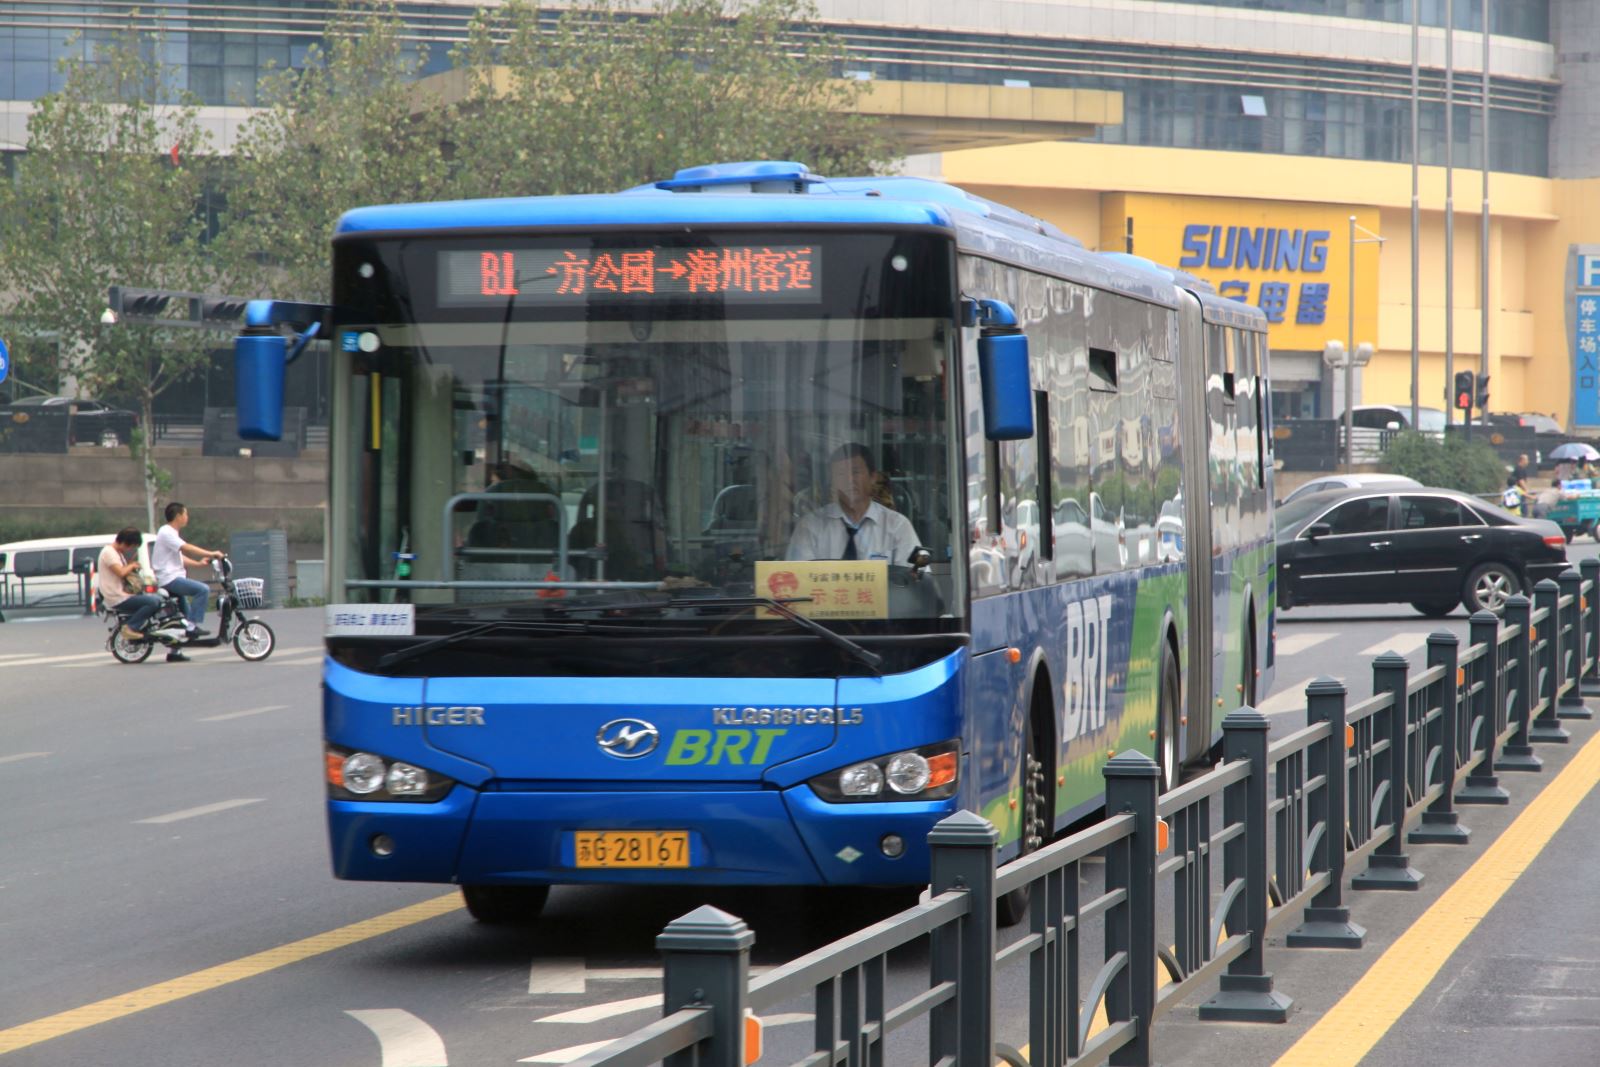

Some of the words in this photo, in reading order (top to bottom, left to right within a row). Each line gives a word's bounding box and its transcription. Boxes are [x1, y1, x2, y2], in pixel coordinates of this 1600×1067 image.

[1179, 224, 1330, 272] SUNING
[809, 588, 874, 605] 示范线
[1062, 594, 1112, 744] BRT
[392, 706, 486, 727] HIGER
[663, 728, 789, 767] BRT
